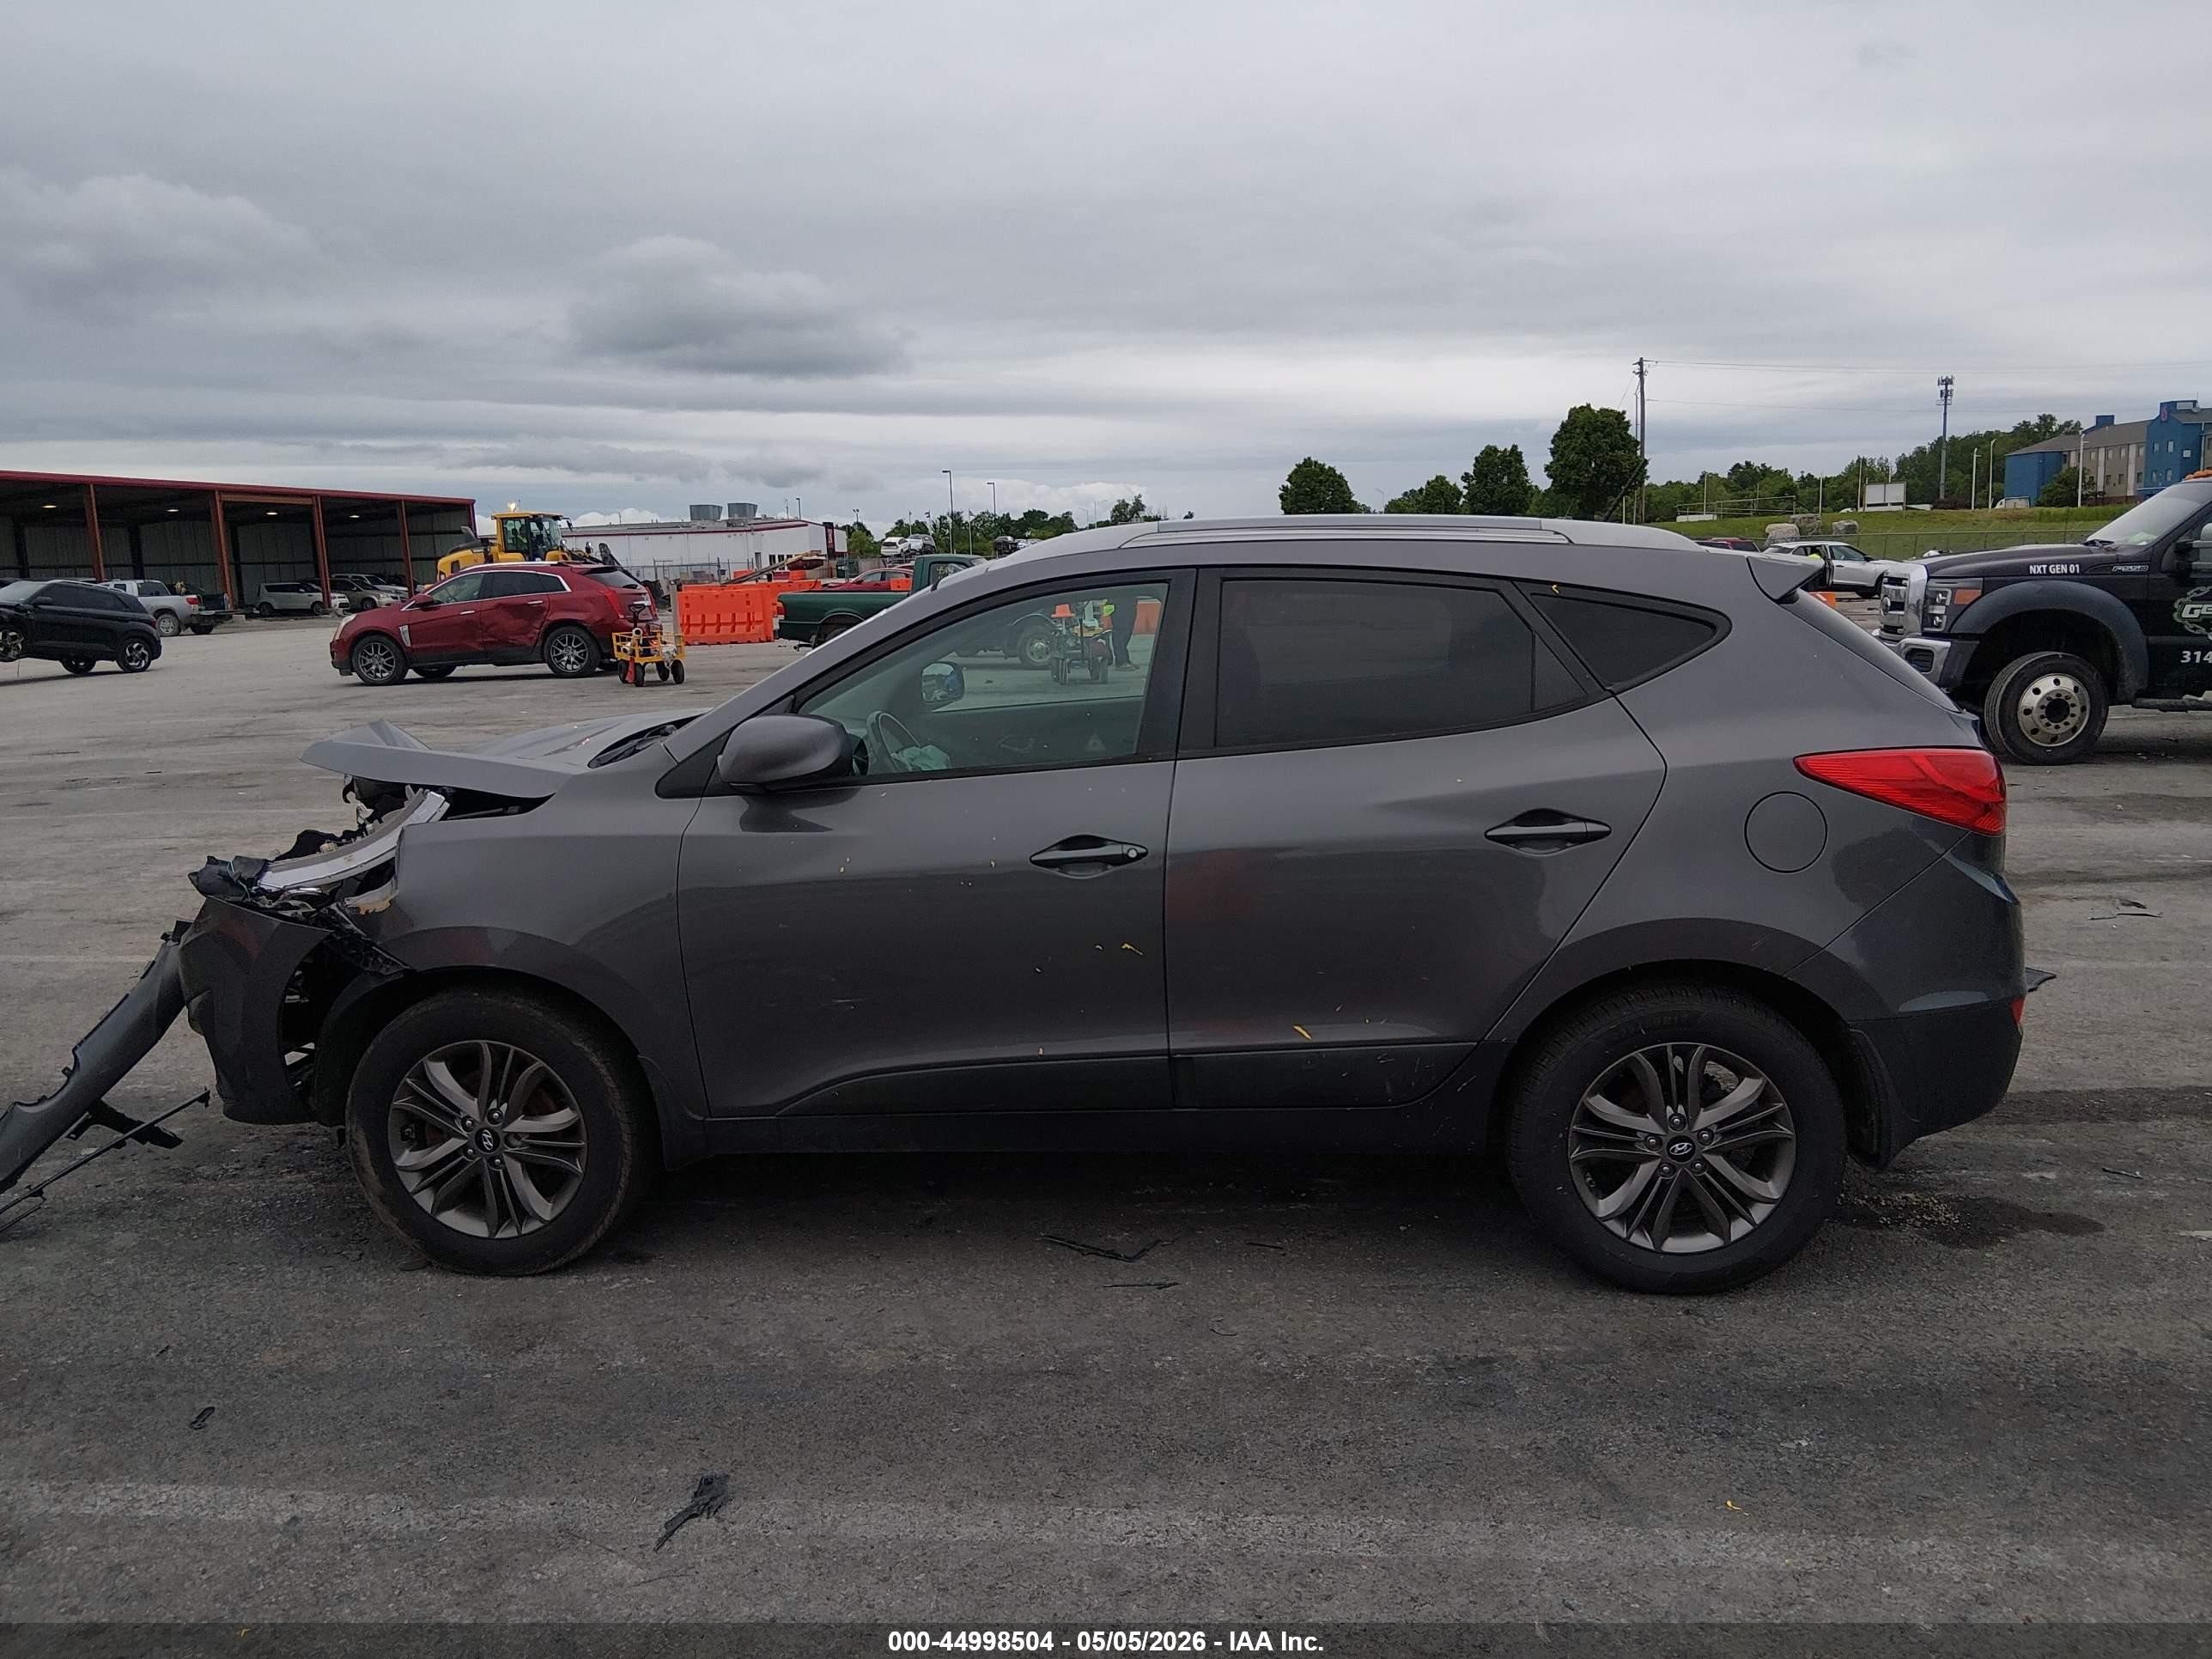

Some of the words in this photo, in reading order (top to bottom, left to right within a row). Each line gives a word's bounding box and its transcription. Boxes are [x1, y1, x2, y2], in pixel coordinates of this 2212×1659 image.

[2029, 564, 2048, 574] NXT
[2049, 564, 2068, 574] GEN
[2069, 563, 2081, 574] 01
[2180, 650, 2212, 664] 314
